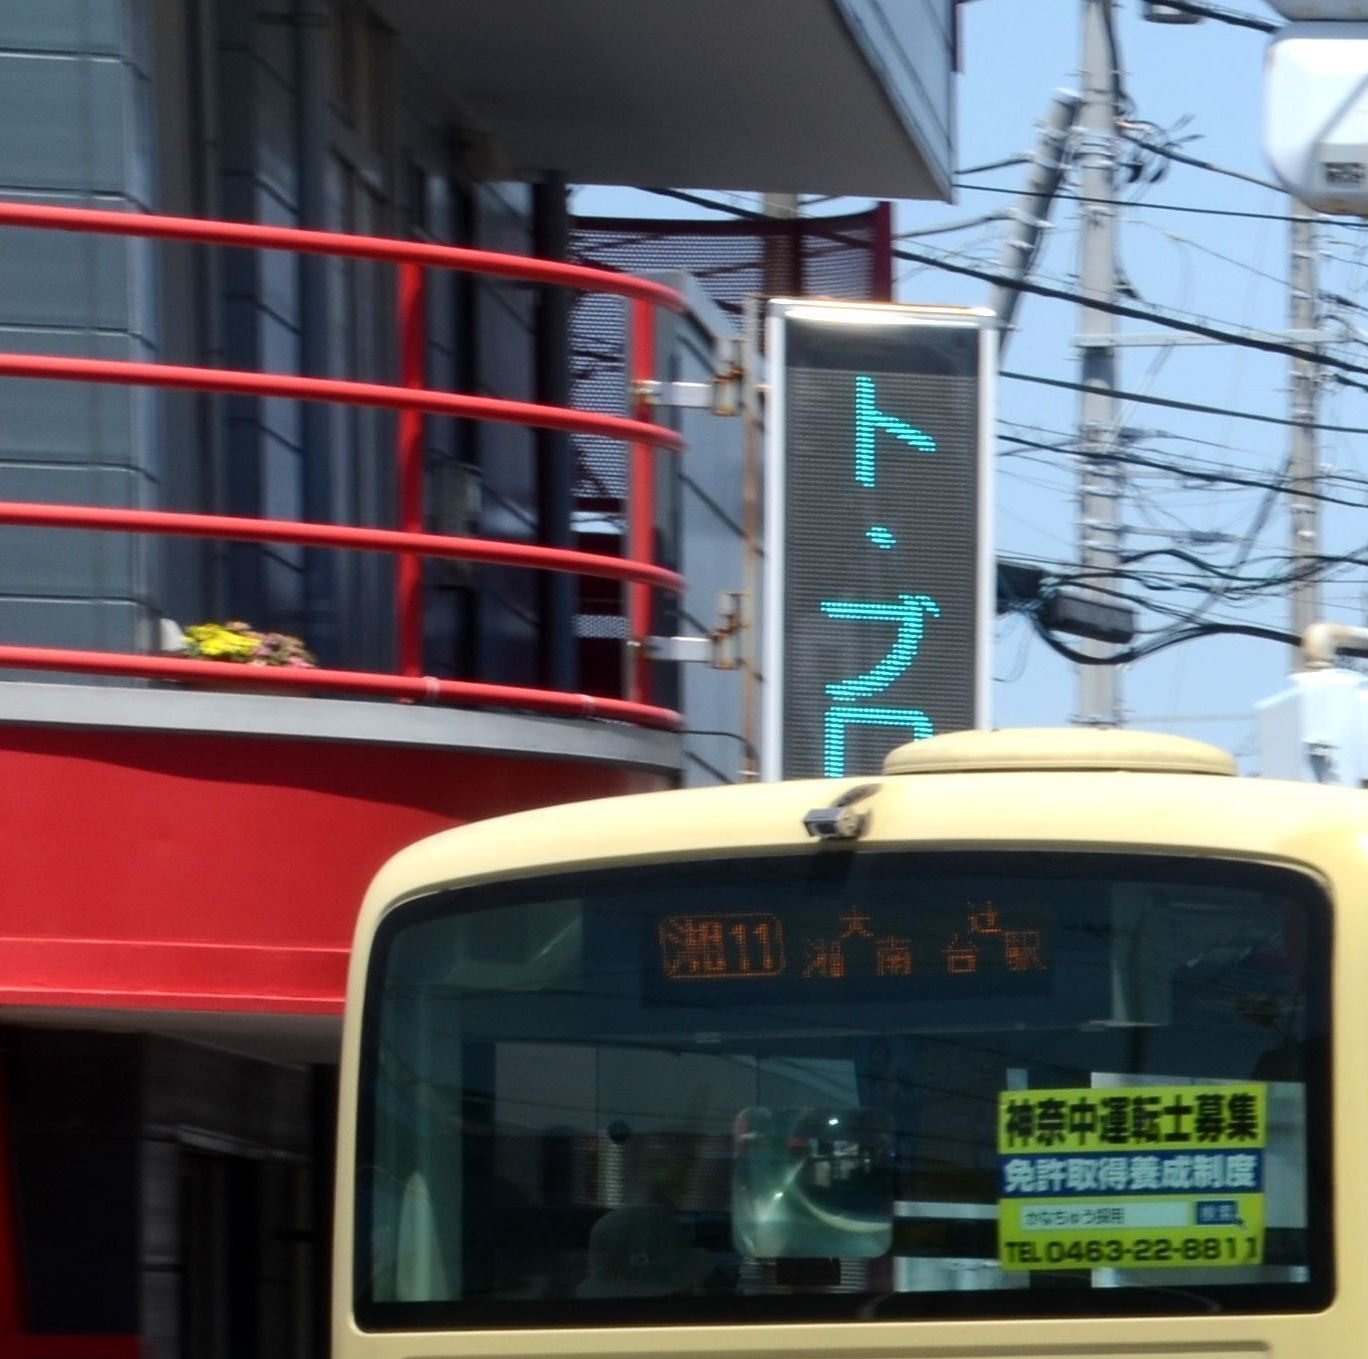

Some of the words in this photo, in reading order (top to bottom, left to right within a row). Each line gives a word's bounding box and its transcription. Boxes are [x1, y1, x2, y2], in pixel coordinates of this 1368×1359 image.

[1006, 1093, 1259, 1148] 神奈中運転士募集
[1004, 1153, 1258, 1193] 免許取得養成制度
